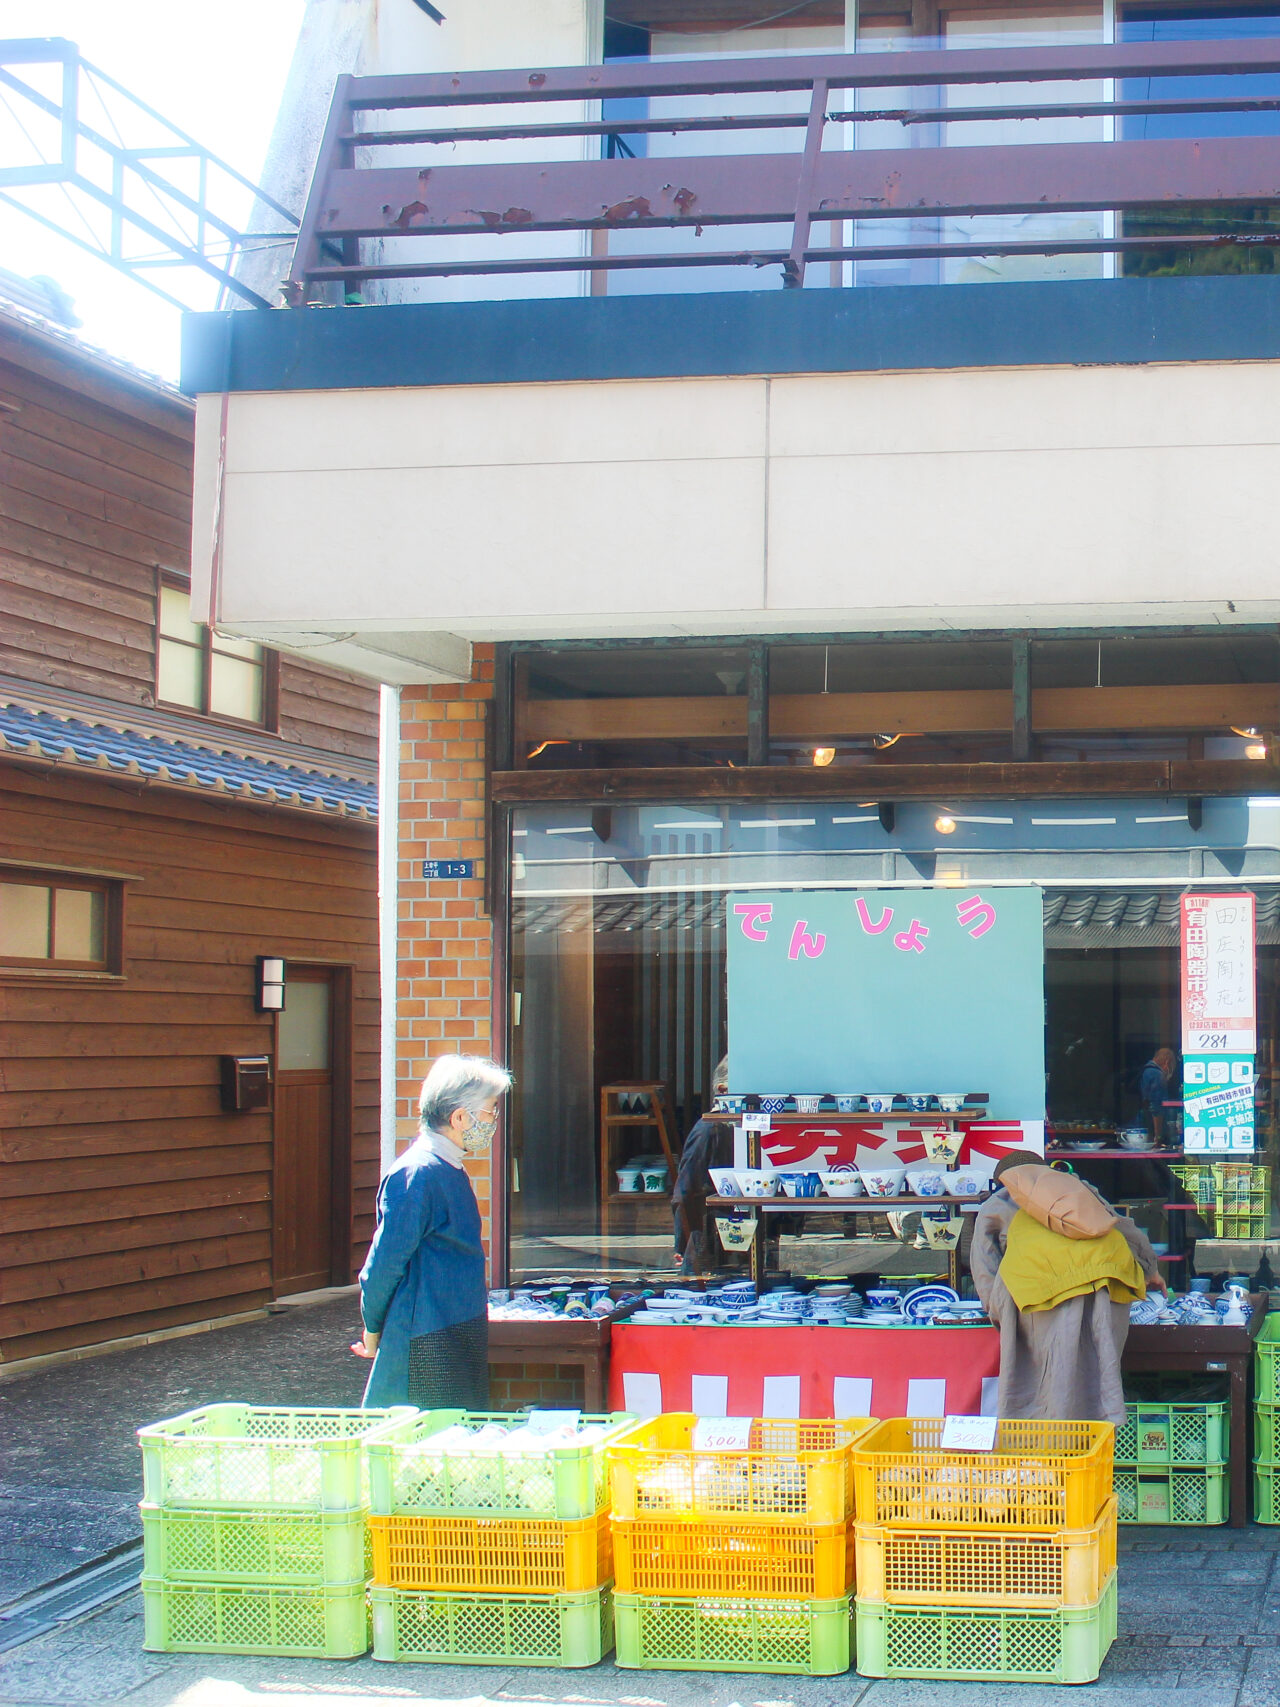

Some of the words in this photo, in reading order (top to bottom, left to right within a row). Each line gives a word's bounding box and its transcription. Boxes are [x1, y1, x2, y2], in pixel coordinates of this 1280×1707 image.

[447, 864, 467, 875] 1-3
[1187, 911, 1207, 992] 有田陶器市
[1206, 1086, 1252, 1104] 有田陶器市登録
[1208, 1099, 1253, 1119] コロナ対策
[1225, 1111, 1254, 1127] 実施店
